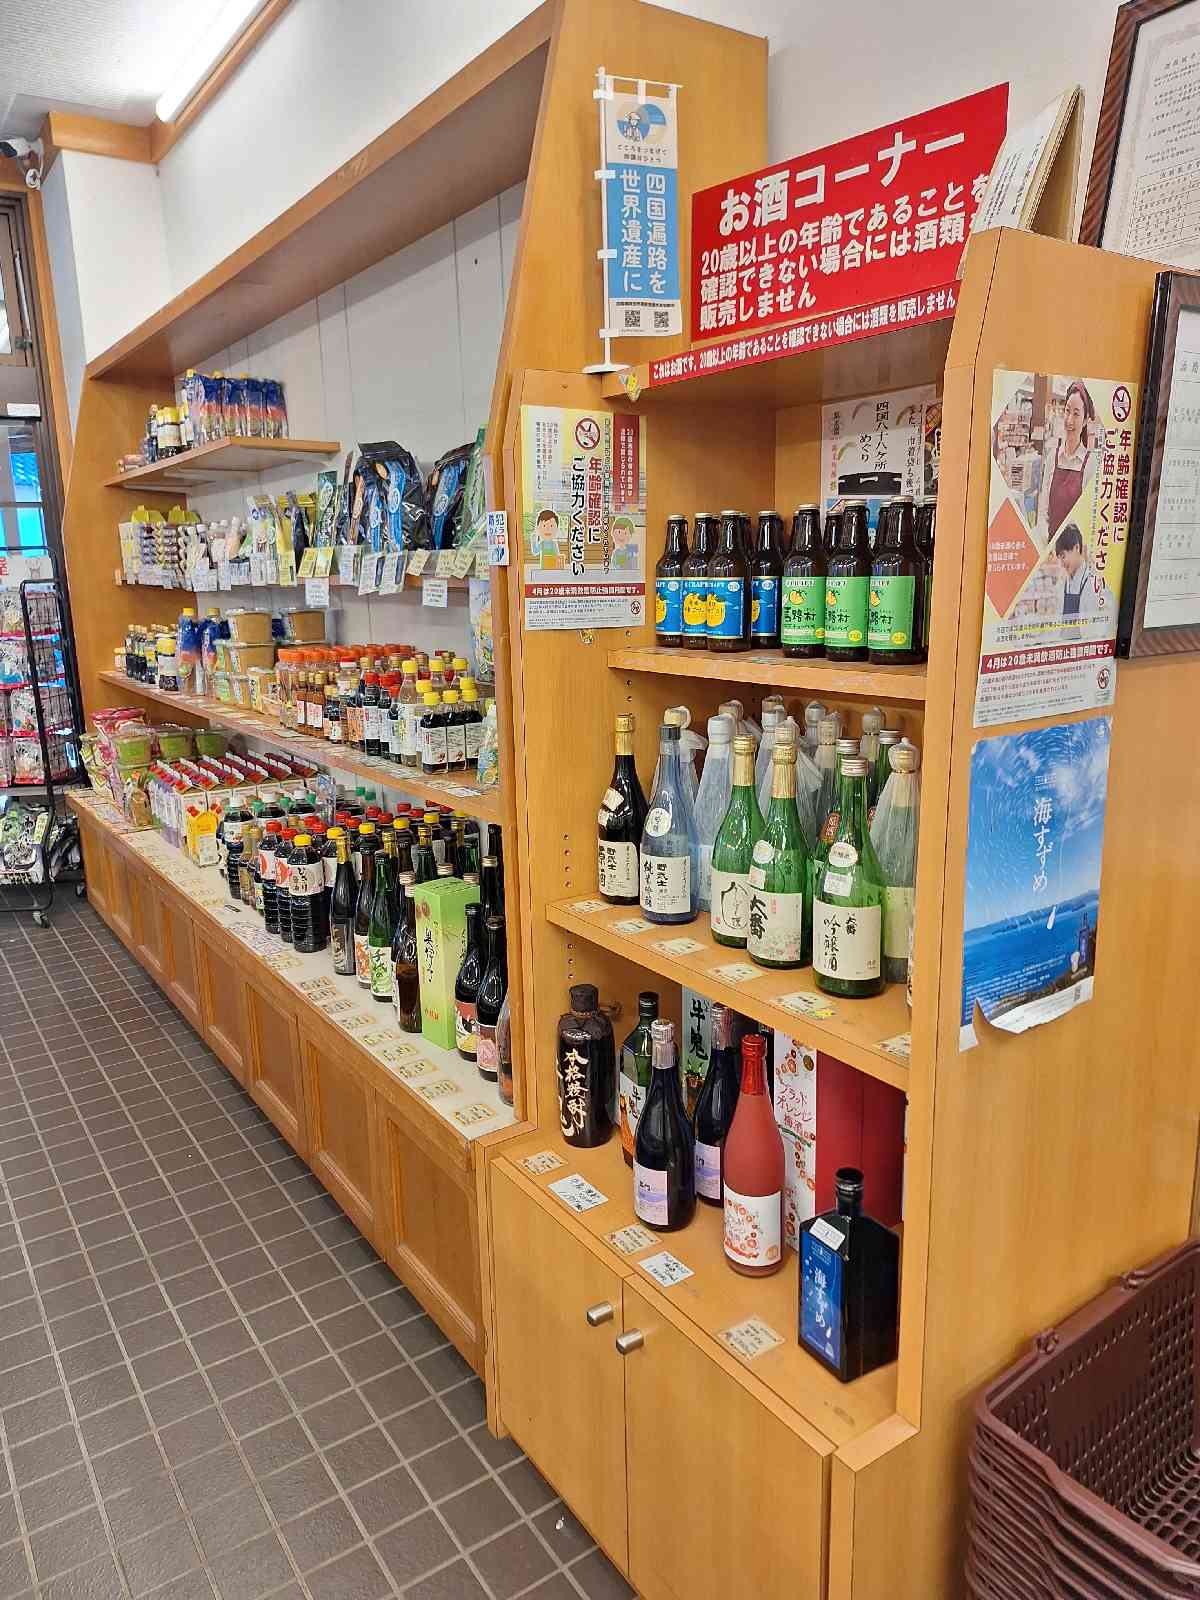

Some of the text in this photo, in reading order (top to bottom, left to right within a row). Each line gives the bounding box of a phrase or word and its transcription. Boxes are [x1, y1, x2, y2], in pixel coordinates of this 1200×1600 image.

[620, 169, 642, 292] 世界遺産に
[646, 173, 667, 294] 四国遍路を
[718, 131, 966, 237] お酒コーナー
[700, 281, 817, 331] 販売しません
[588, 456, 602, 543] 年齢確認に
[859, 434, 872, 463] めぐり
[1113, 430, 1132, 544] 年齢確認に
[571, 455, 585, 576] ご協力ください
[1092, 429, 1119, 608] ご協力ください。
[1031, 797, 1054, 892] 海すずめ
